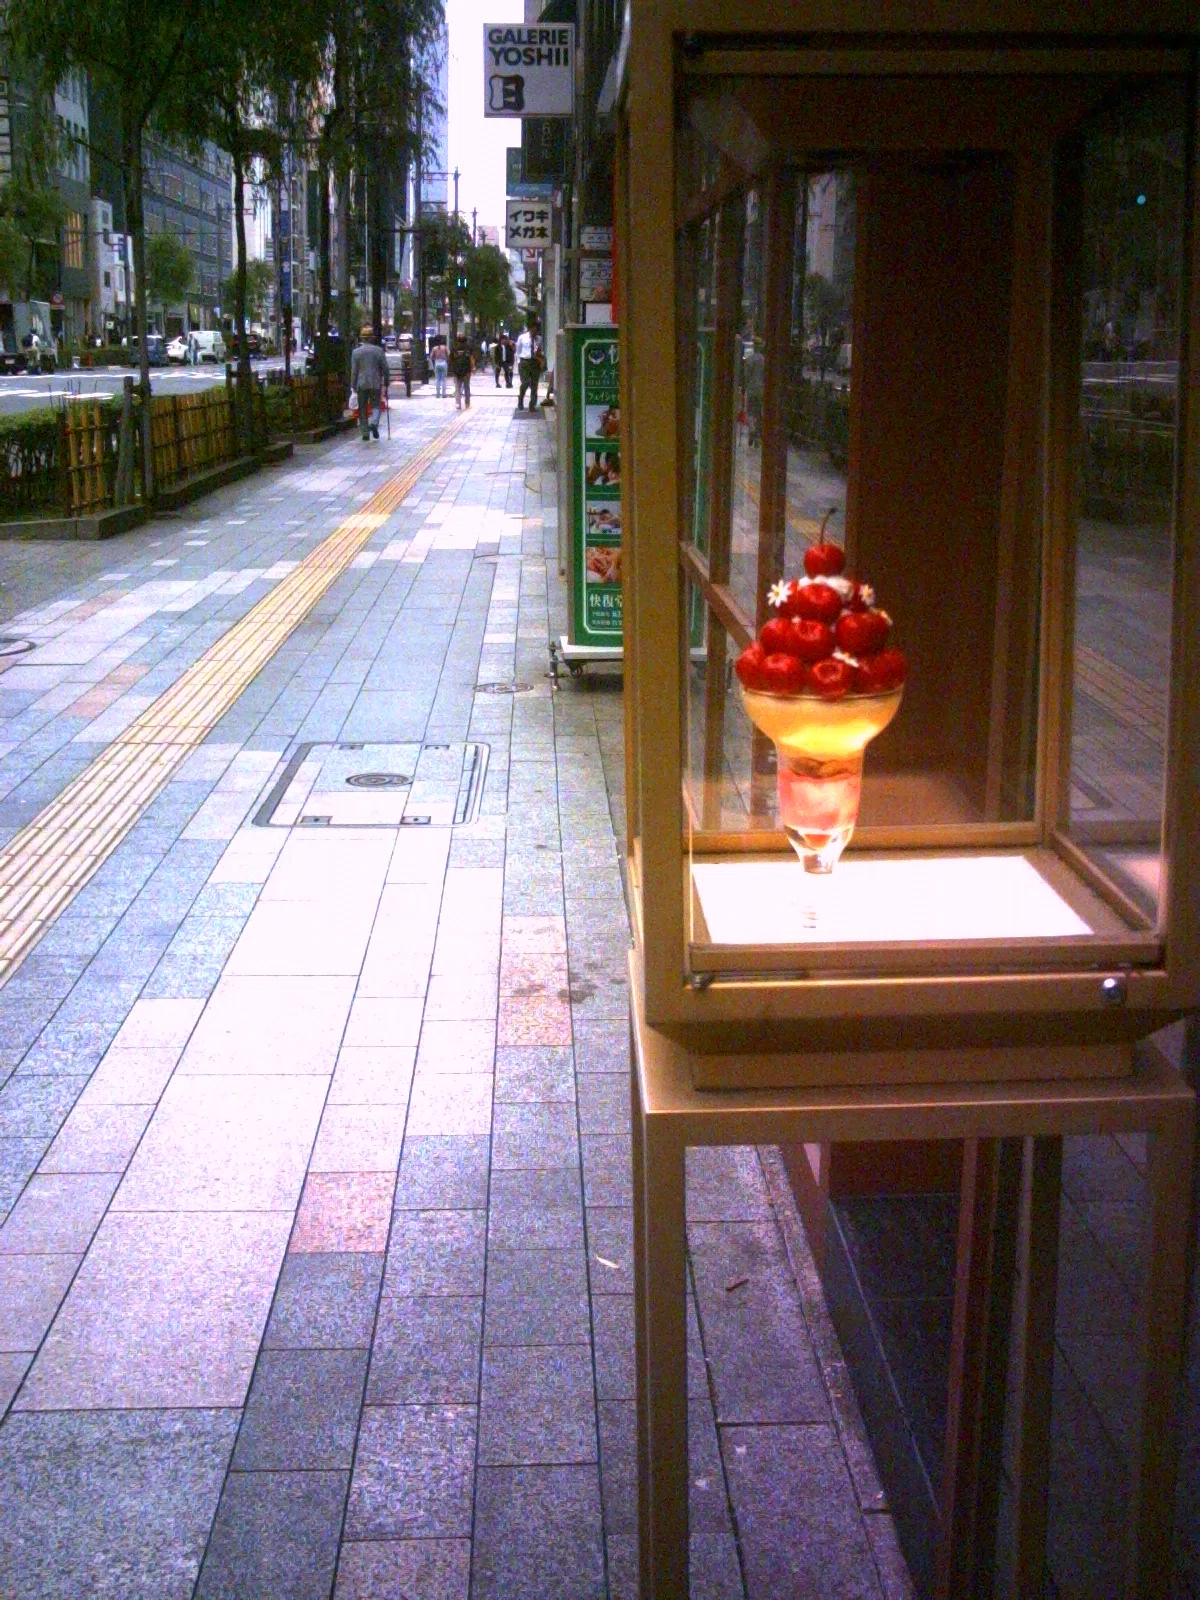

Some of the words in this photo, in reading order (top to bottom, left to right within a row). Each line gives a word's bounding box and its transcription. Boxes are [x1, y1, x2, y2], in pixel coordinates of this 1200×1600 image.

[488, 29, 569, 44] GALERIE
[488, 47, 569, 66] YOSHII
[509, 209, 549, 223] イワキ
[509, 226, 549, 239] メガネ
